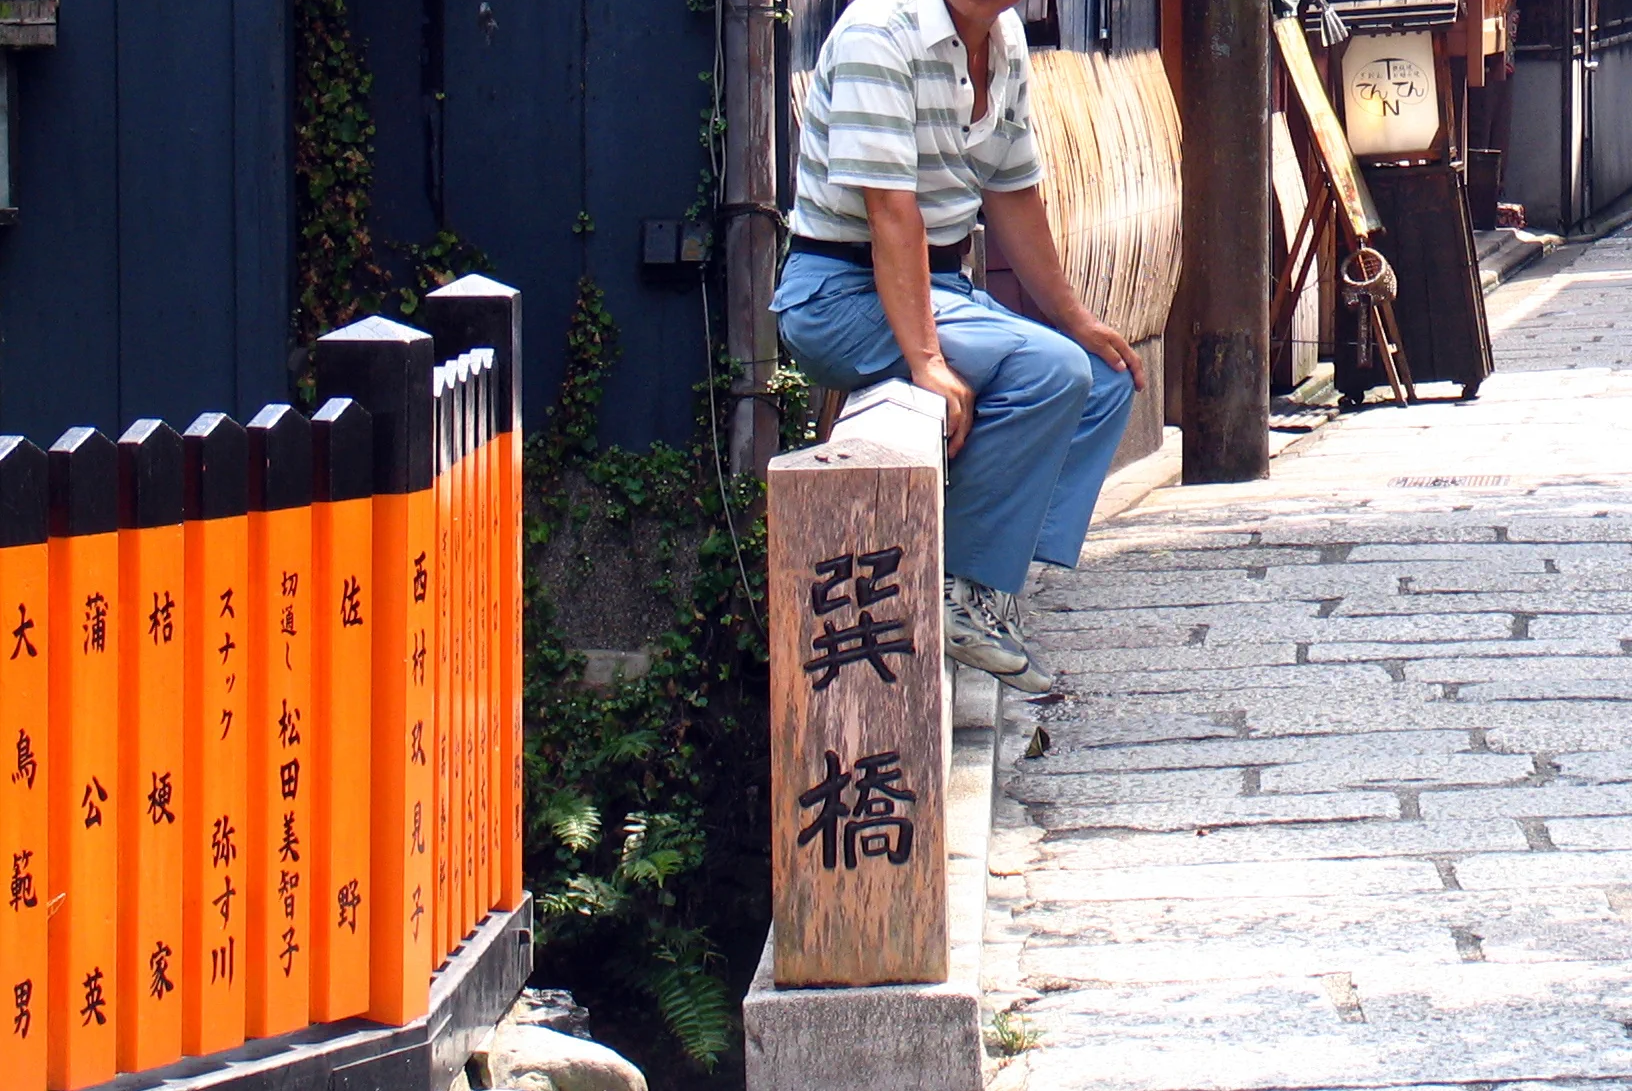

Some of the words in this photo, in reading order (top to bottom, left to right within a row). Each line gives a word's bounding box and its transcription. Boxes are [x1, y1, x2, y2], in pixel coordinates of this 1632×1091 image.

[1356, 82, 1388, 100] てん
[1392, 81, 1425, 98] てん
[1382, 99, 1400, 116] N
[218, 588, 236, 741] スナック
[280, 571, 298, 670] 切通し
[337, 575, 364, 935] 佐野
[797, 546, 916, 870] 巽橋
[9, 602, 38, 1041] 大鳥範男
[79, 592, 109, 1028] 蒲公英
[147, 590, 176, 1001] 桔梗家
[211, 814, 237, 986] 弥す川
[278, 698, 301, 978] 松田美智子
